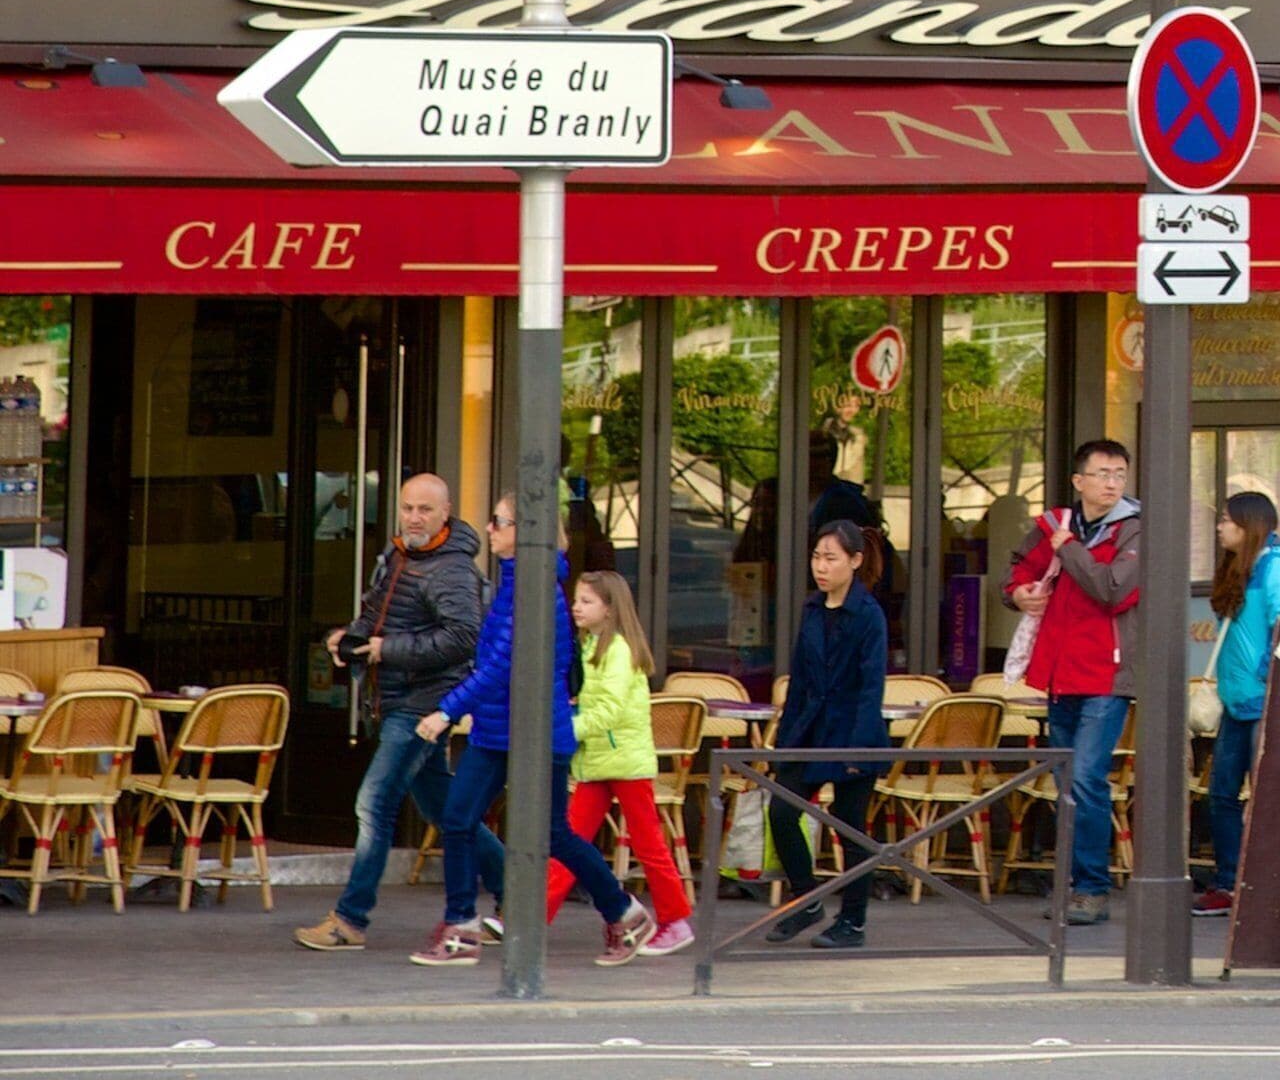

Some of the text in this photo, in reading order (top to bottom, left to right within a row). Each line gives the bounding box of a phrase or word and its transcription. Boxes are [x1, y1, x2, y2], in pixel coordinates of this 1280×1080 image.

[418, 59, 610, 93] Musée du
[419, 105, 652, 145] Quai Branly
[164, 220, 362, 271] CAFE
[755, 224, 1013, 272] CREPES
